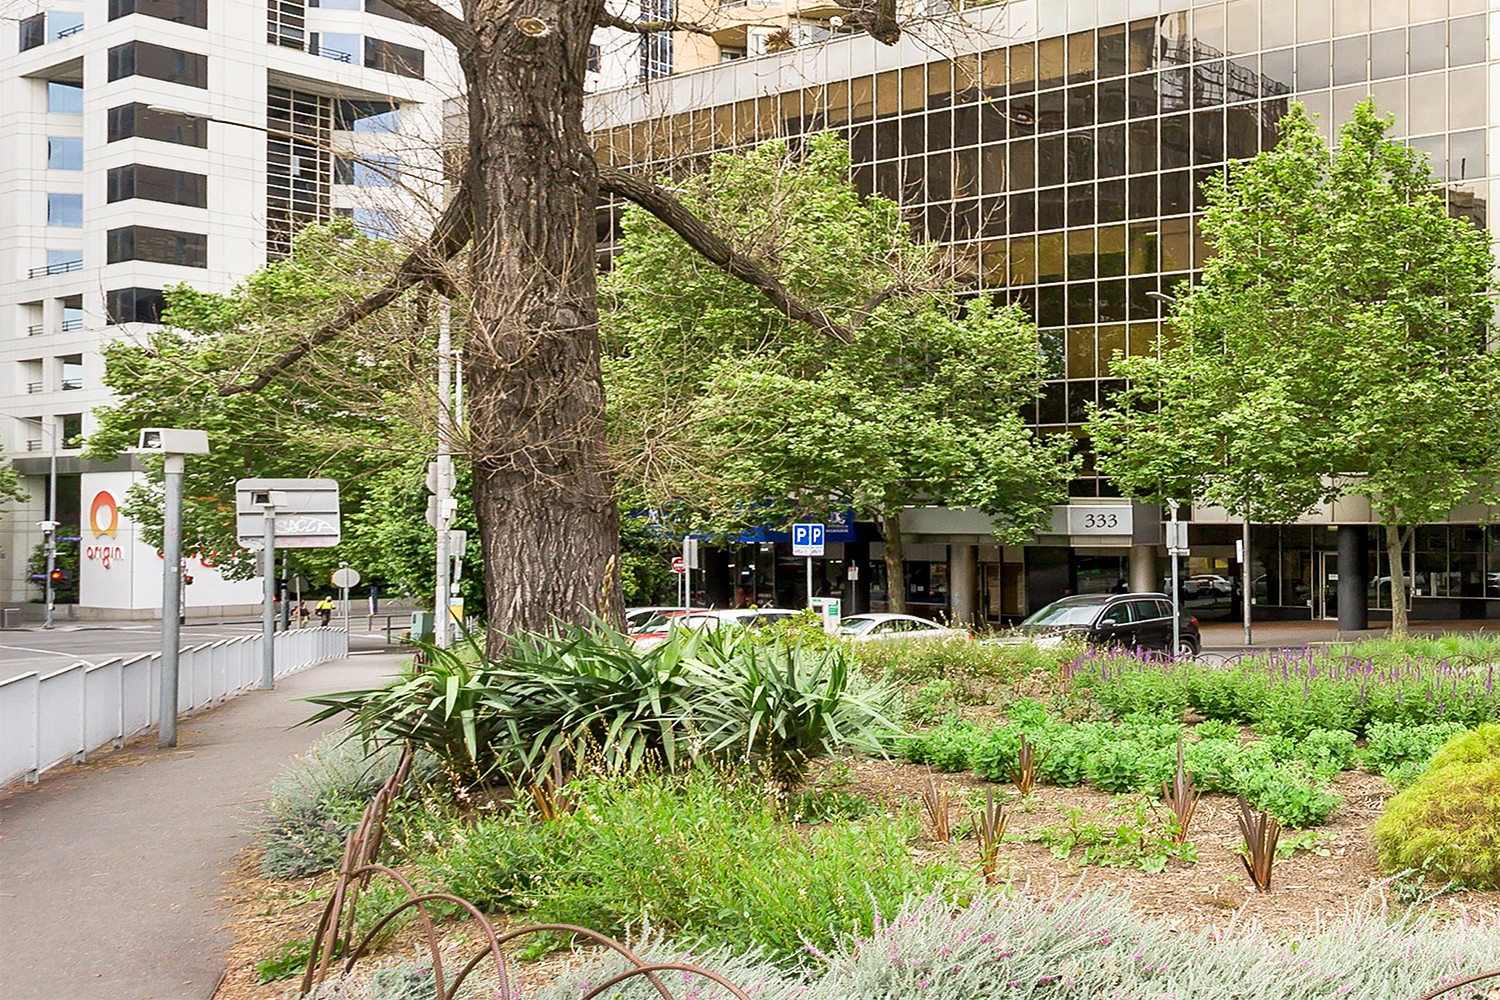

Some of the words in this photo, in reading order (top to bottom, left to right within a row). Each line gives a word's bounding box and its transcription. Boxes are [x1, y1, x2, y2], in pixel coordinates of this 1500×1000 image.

[1085, 513, 1118, 528] 333
[796, 527, 807, 543] P
[813, 527, 821, 543] P
[86, 546, 122, 569] origin
